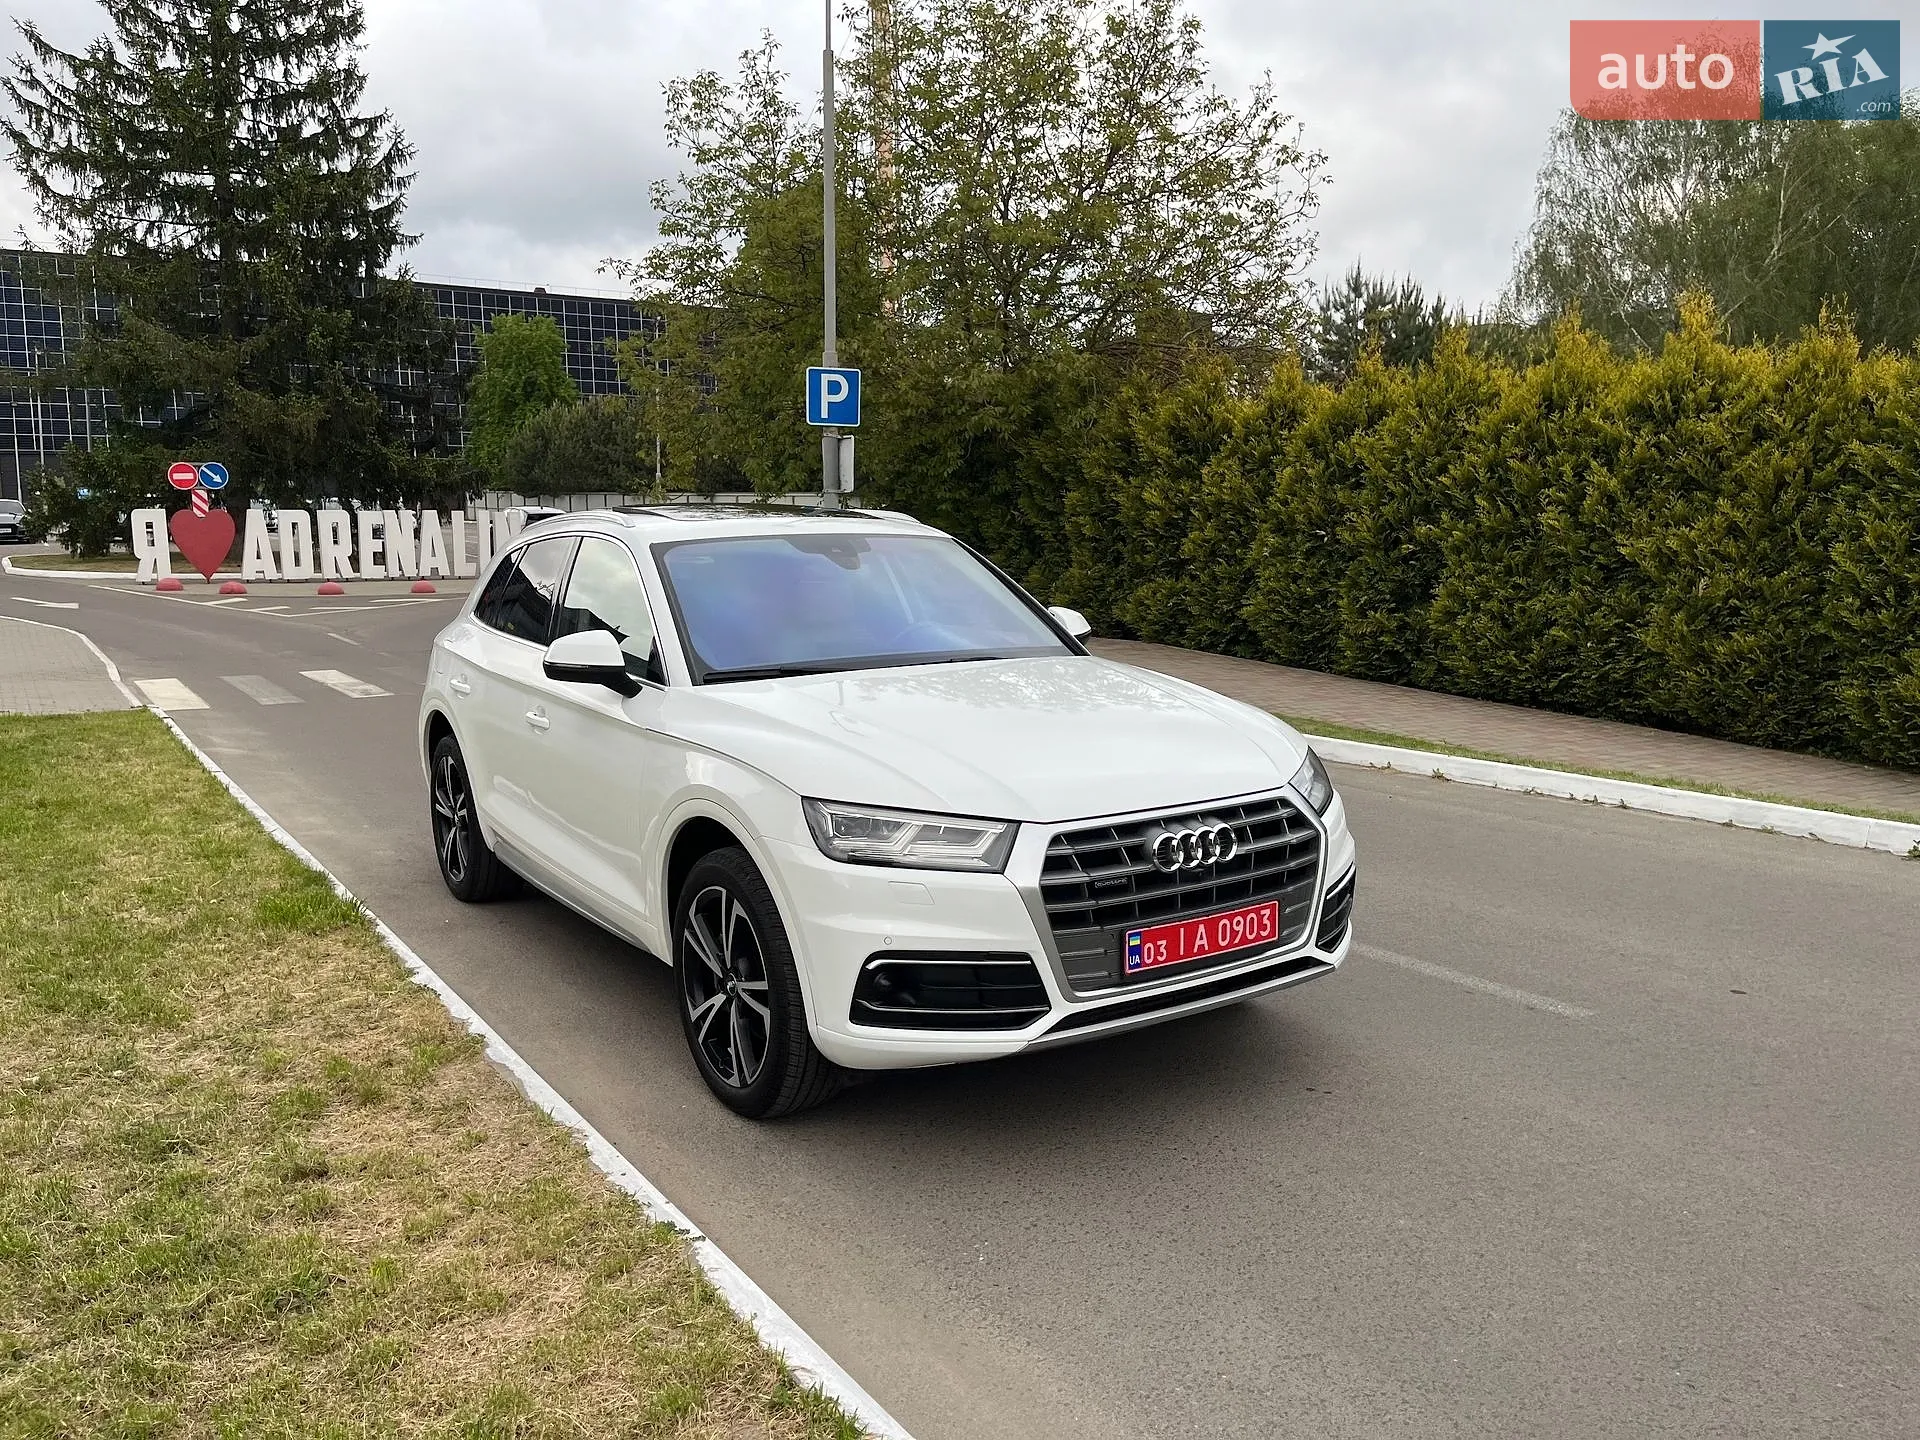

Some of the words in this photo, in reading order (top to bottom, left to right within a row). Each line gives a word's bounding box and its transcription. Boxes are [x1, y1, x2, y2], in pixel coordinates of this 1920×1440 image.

[821, 373, 849, 419] P
[131, 508, 171, 583] Я
[1129, 954, 1141, 966] UA
[1143, 940, 1168, 964] 03
[1217, 908, 1272, 947] 0903
